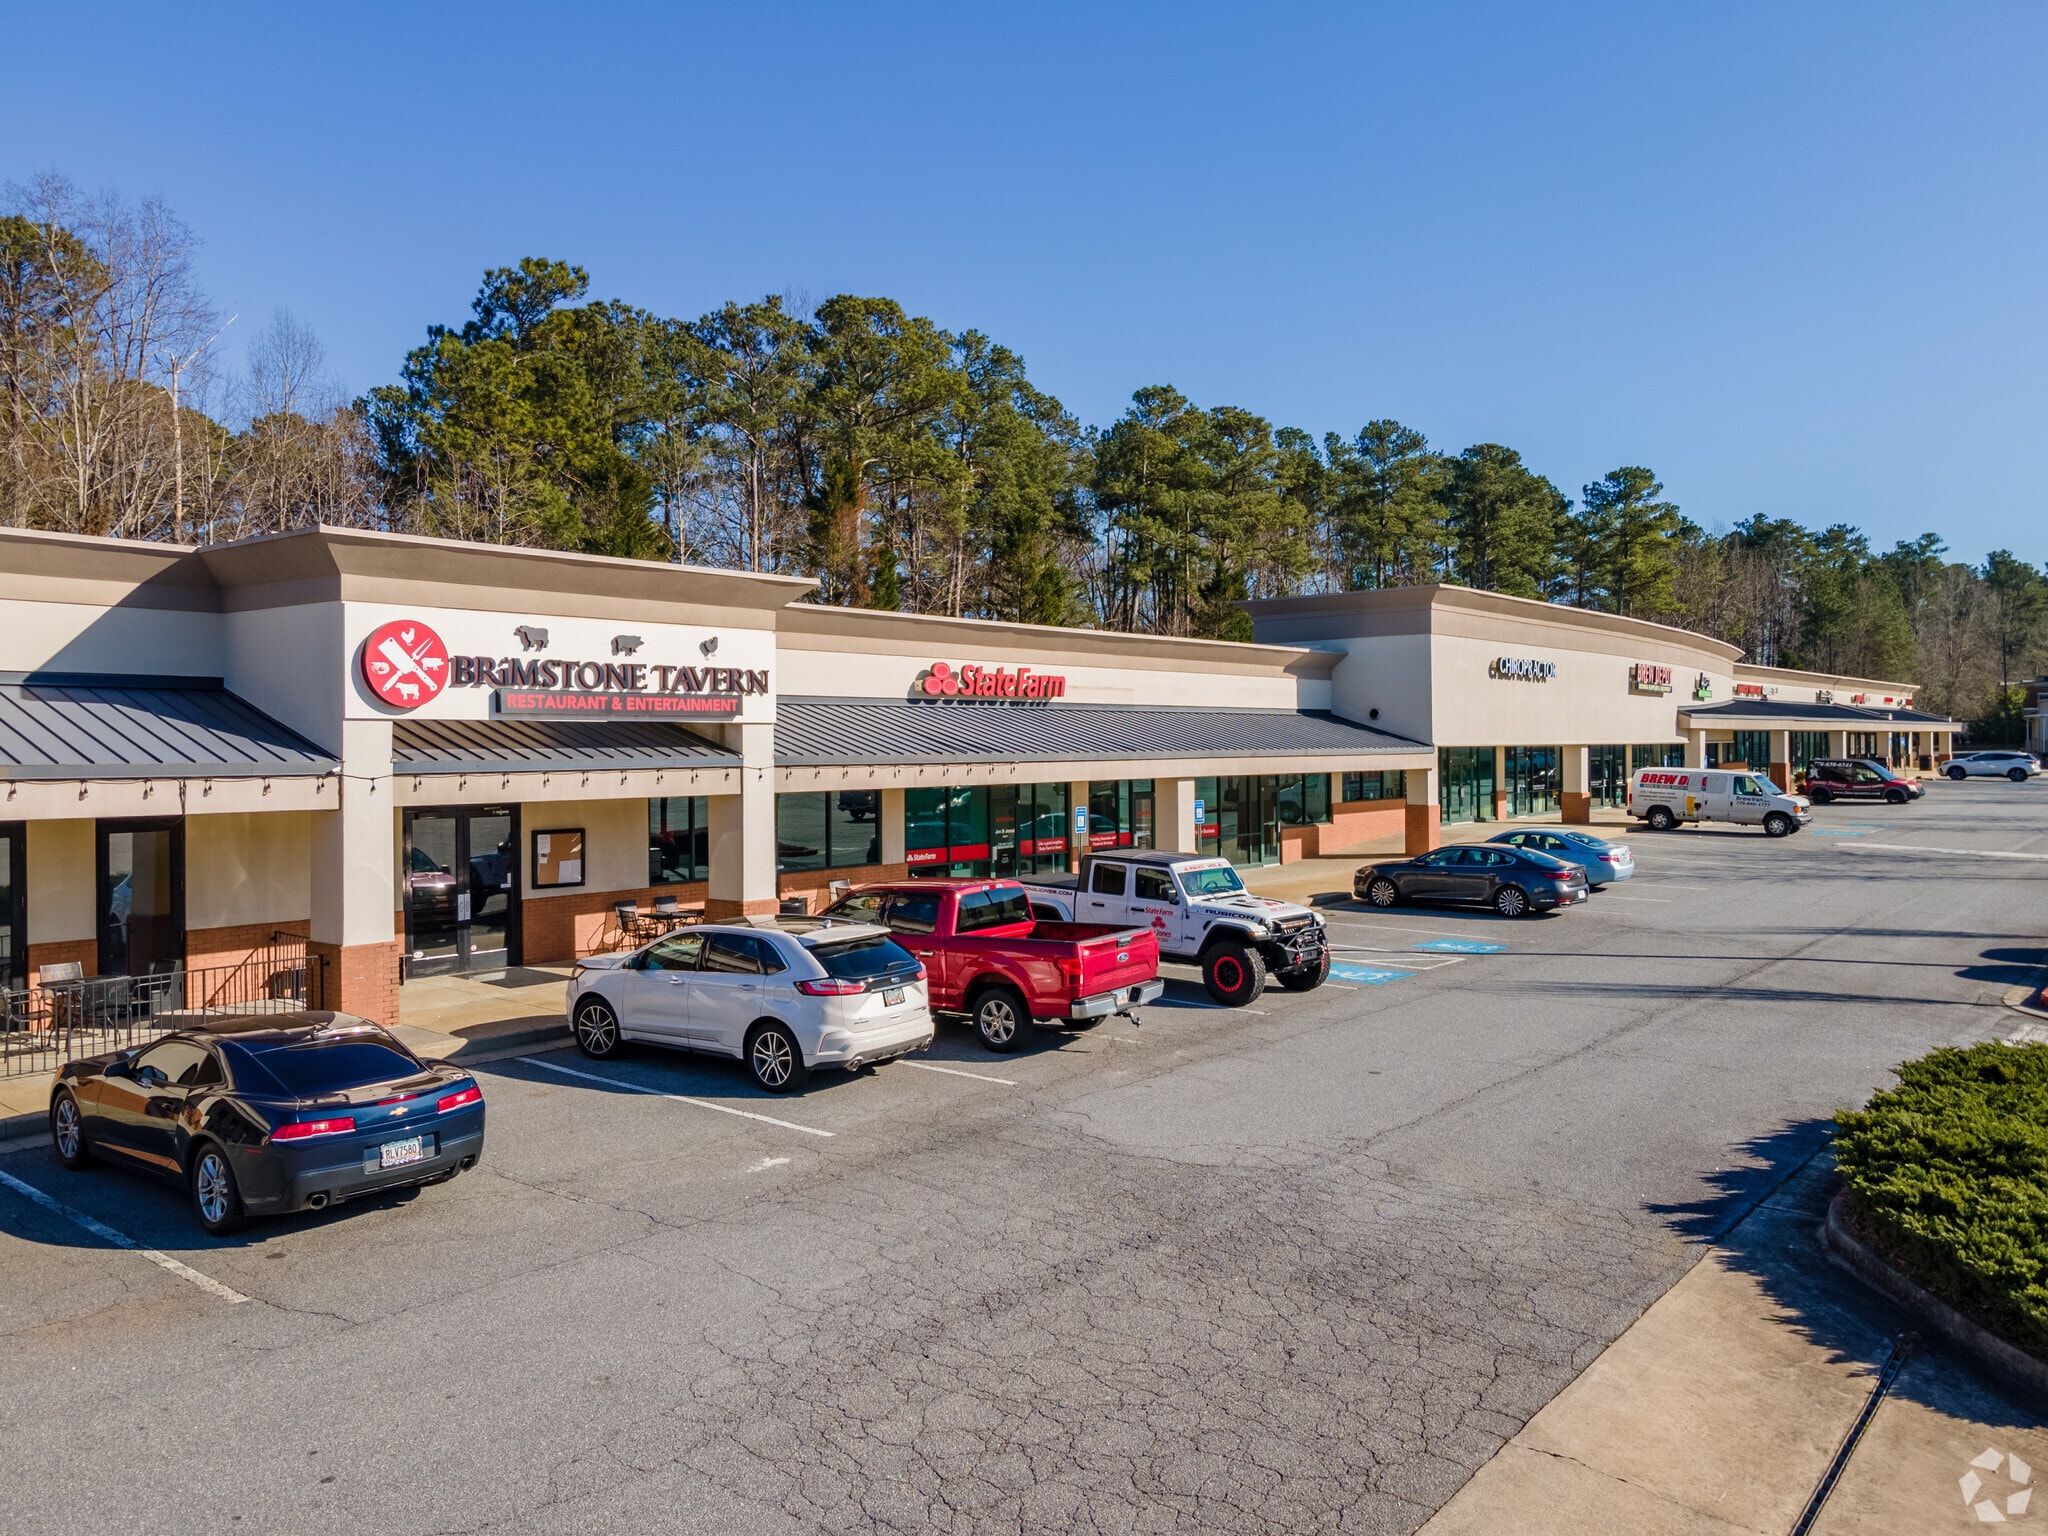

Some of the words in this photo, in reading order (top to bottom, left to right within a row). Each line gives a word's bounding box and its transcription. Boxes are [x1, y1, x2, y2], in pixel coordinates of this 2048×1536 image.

[1500, 657, 1557, 678] CHIROPRACTOR
[1638, 664, 1655, 683] BREW
[1656, 666, 1671, 684] DEPOT
[650, 664, 769, 695] TAVERN
[506, 693, 608, 711] RESTAURANT
[611, 695, 623, 711] &
[626, 695, 738, 713] ENTERTAINMENT
[1640, 773, 1678, 785] BREW
[1205, 909, 1256, 921] RUBICON
